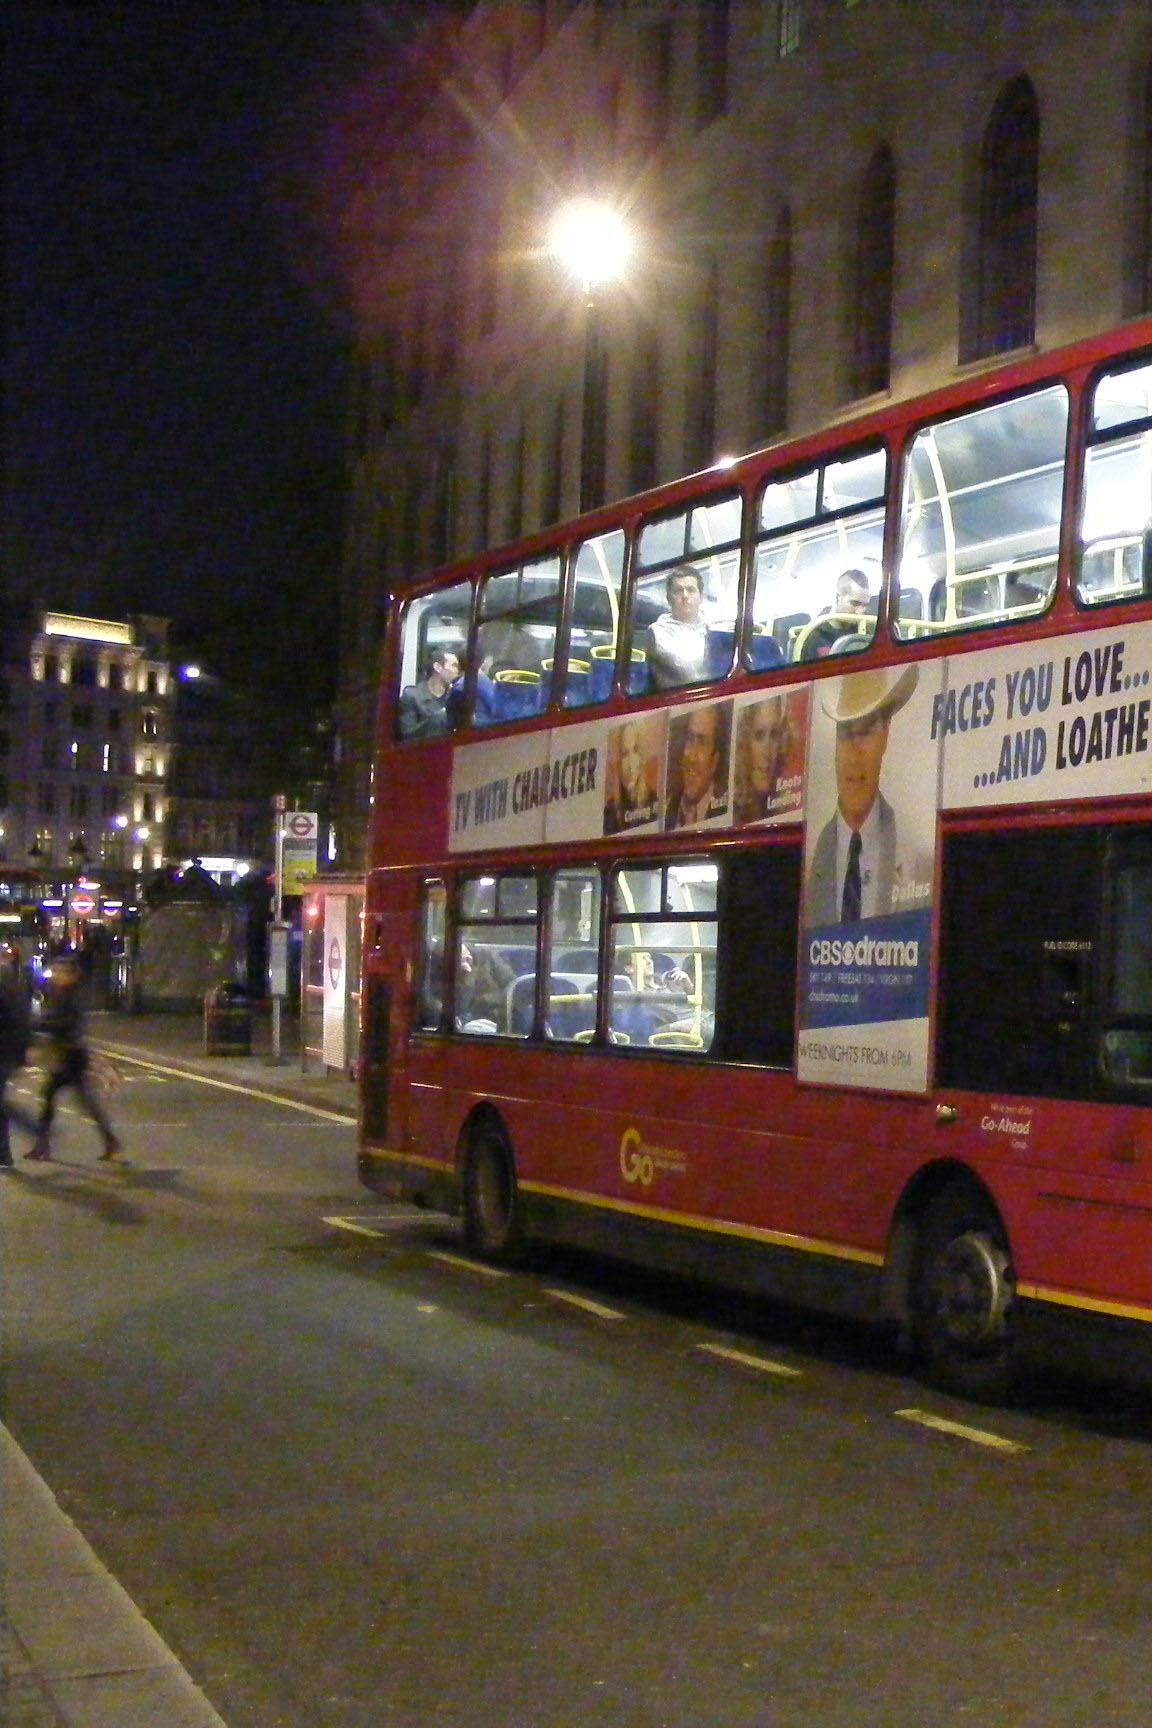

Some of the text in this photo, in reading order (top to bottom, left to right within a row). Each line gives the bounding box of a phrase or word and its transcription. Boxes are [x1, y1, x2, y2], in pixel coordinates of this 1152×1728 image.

[930, 641, 1150, 740] FACES YOU LOVE...
[1055, 700, 1151, 771] LOATHE
[453, 748, 598, 832] TV WITH CHARACTER
[799, 1042, 859, 1066] WEEKNIGHTS
[861, 1046, 889, 1067] FROM
[620, 1127, 654, 1186] Go
[981, 1115, 1031, 1135] Go-Ahead
